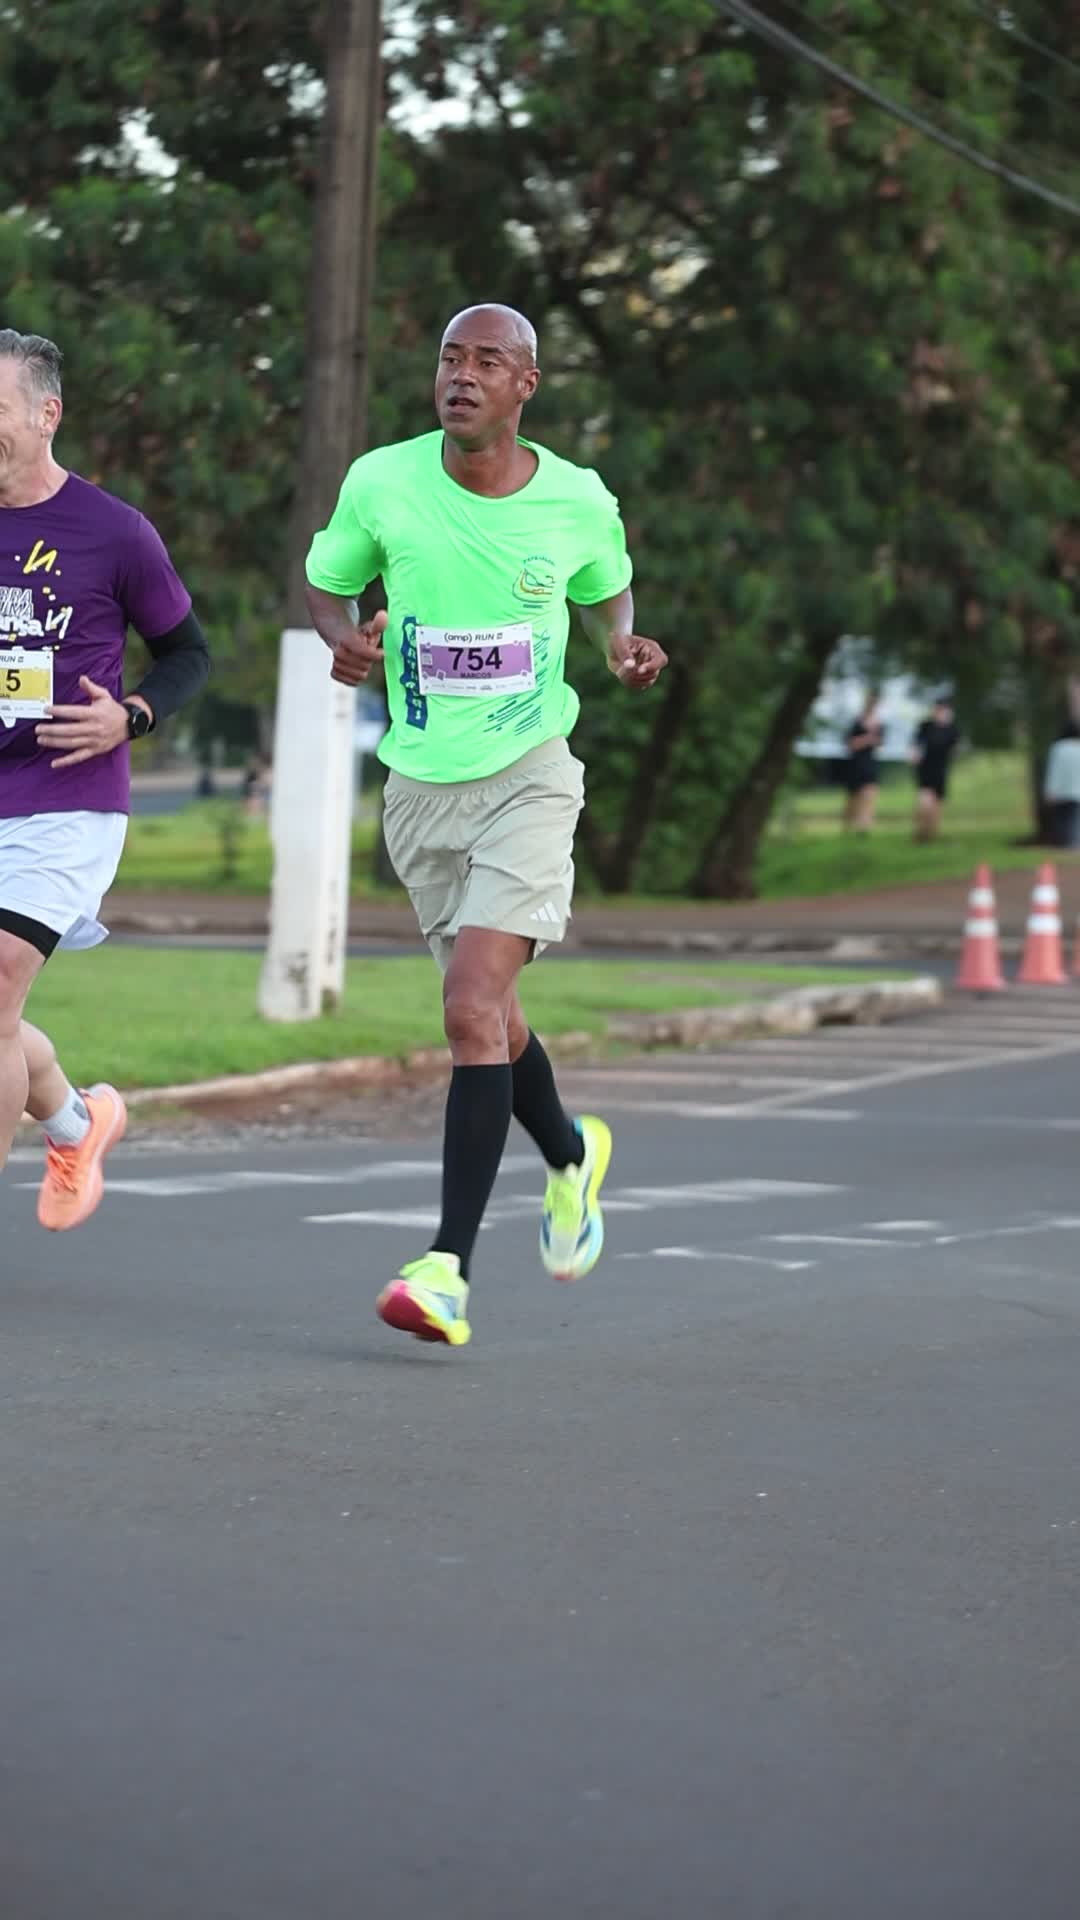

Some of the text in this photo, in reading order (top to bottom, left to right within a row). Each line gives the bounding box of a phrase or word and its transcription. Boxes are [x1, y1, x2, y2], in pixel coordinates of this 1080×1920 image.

[444, 632, 472, 643] (amp)
[475, 633, 494, 641] RUN
[448, 646, 503, 671] 754
[6, 669, 21, 692] 5
